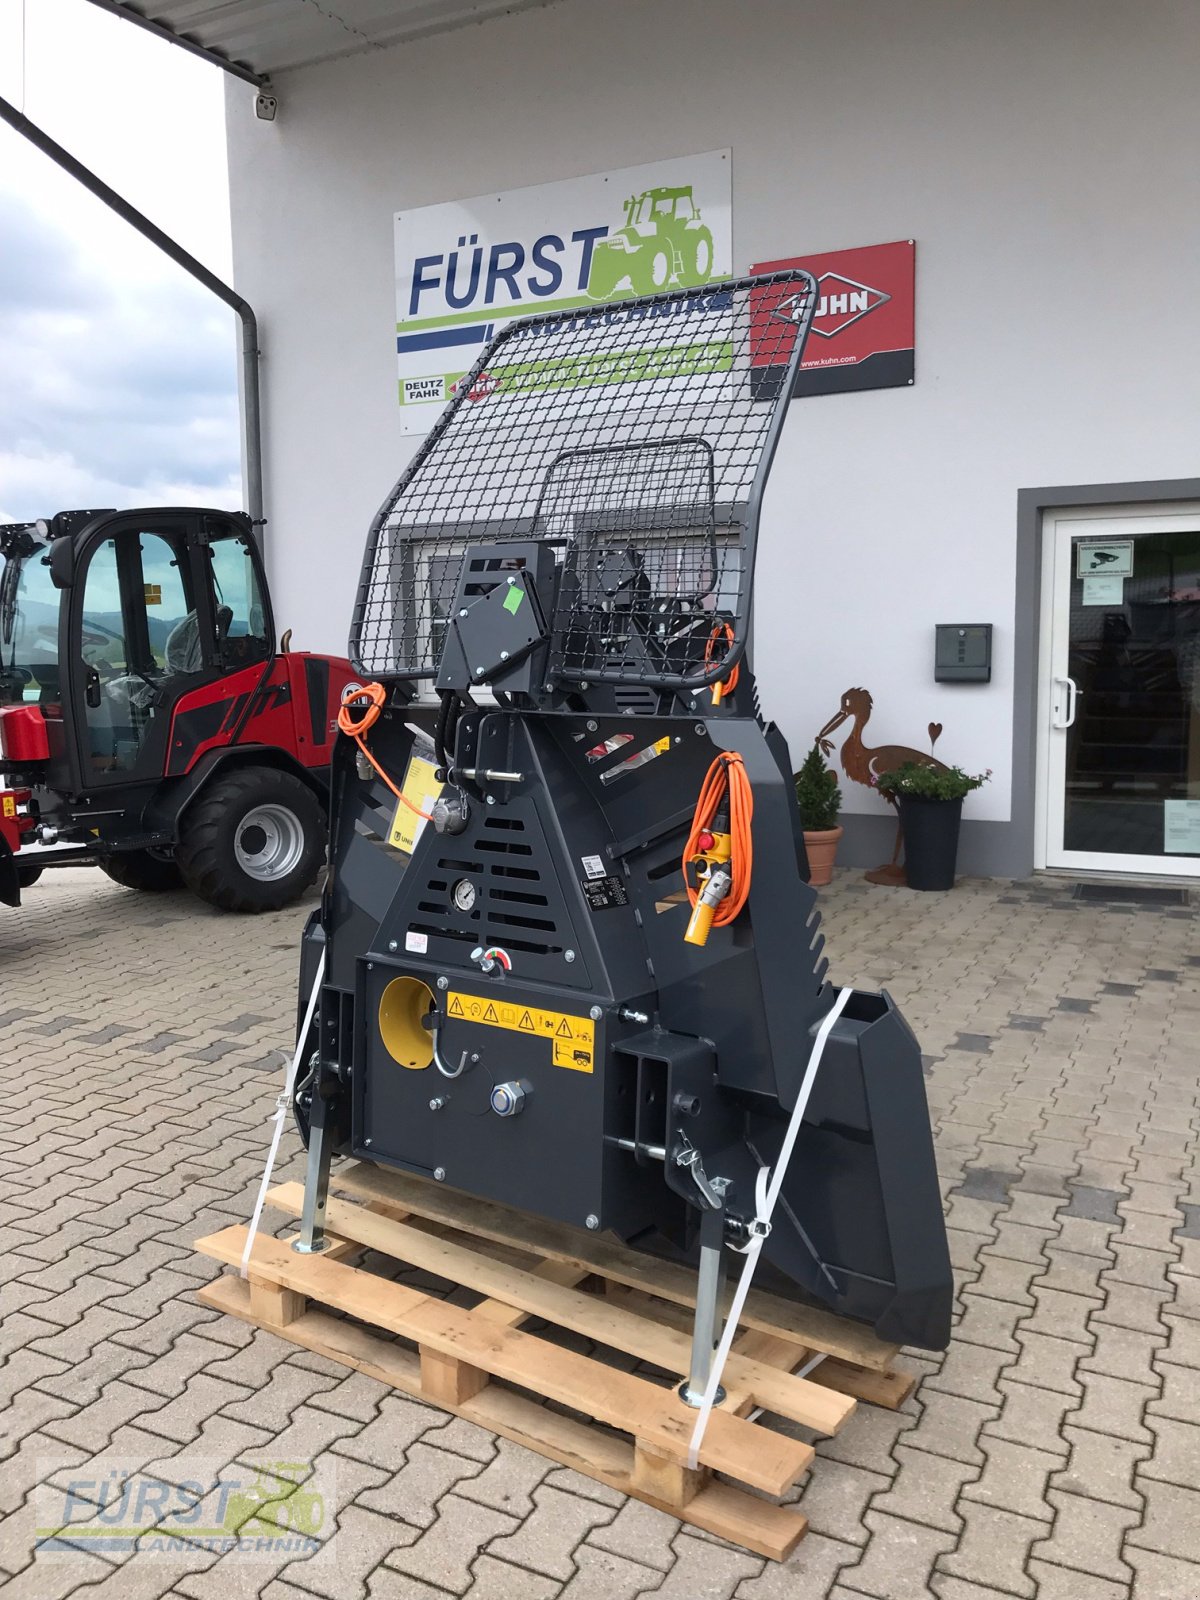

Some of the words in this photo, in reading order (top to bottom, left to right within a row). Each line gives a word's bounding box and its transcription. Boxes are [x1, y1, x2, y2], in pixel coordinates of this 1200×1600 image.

[409, 226, 609, 315] FÜRST
[801, 355, 857, 368] www.kuhn.com
[405, 379, 444, 391] DEUTZ
[409, 388, 440, 400] FAHR
